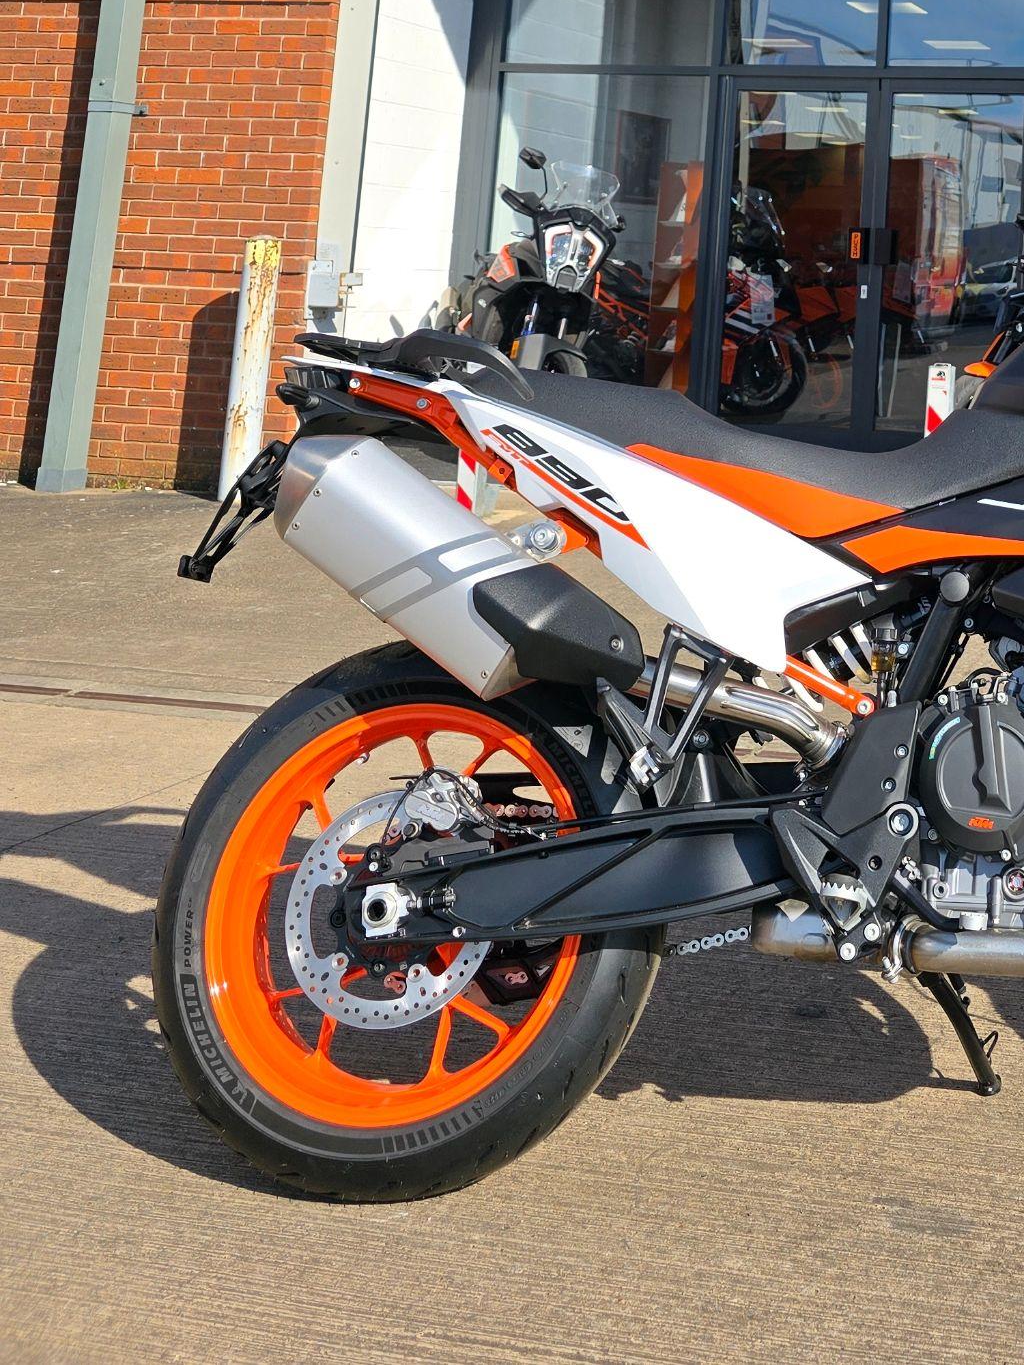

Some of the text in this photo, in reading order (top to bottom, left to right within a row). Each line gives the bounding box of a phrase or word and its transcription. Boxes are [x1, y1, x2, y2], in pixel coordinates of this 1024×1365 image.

[492, 424, 630, 522] 890
[967, 816, 995, 830] KTM
[184, 909, 195, 968] POWER
[183, 983, 234, 1084] MICHELIN
